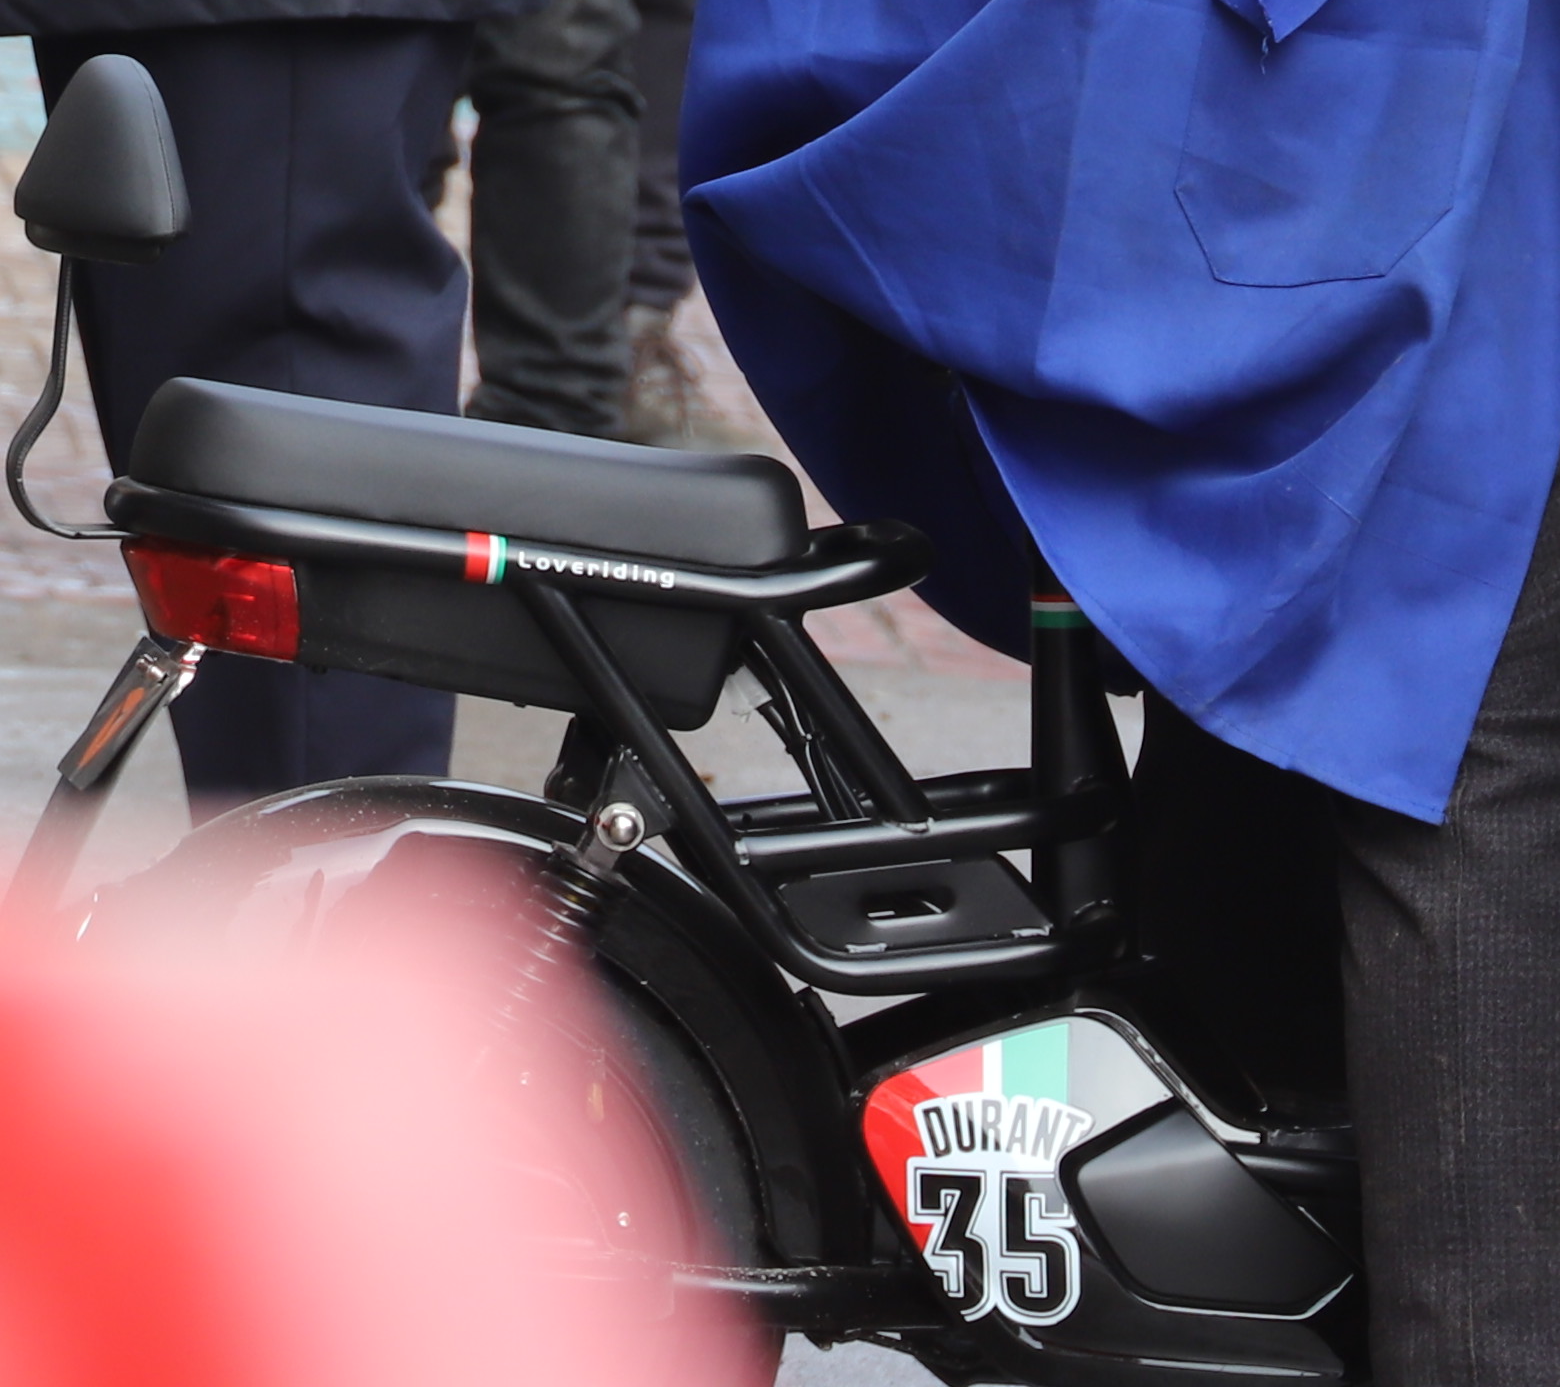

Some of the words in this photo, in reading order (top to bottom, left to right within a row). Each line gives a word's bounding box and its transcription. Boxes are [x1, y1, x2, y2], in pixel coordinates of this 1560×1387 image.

[517, 551, 676, 589] Loveriding
[922, 1098, 1085, 1161] DURANT
[915, 1167, 1080, 1324] 35
